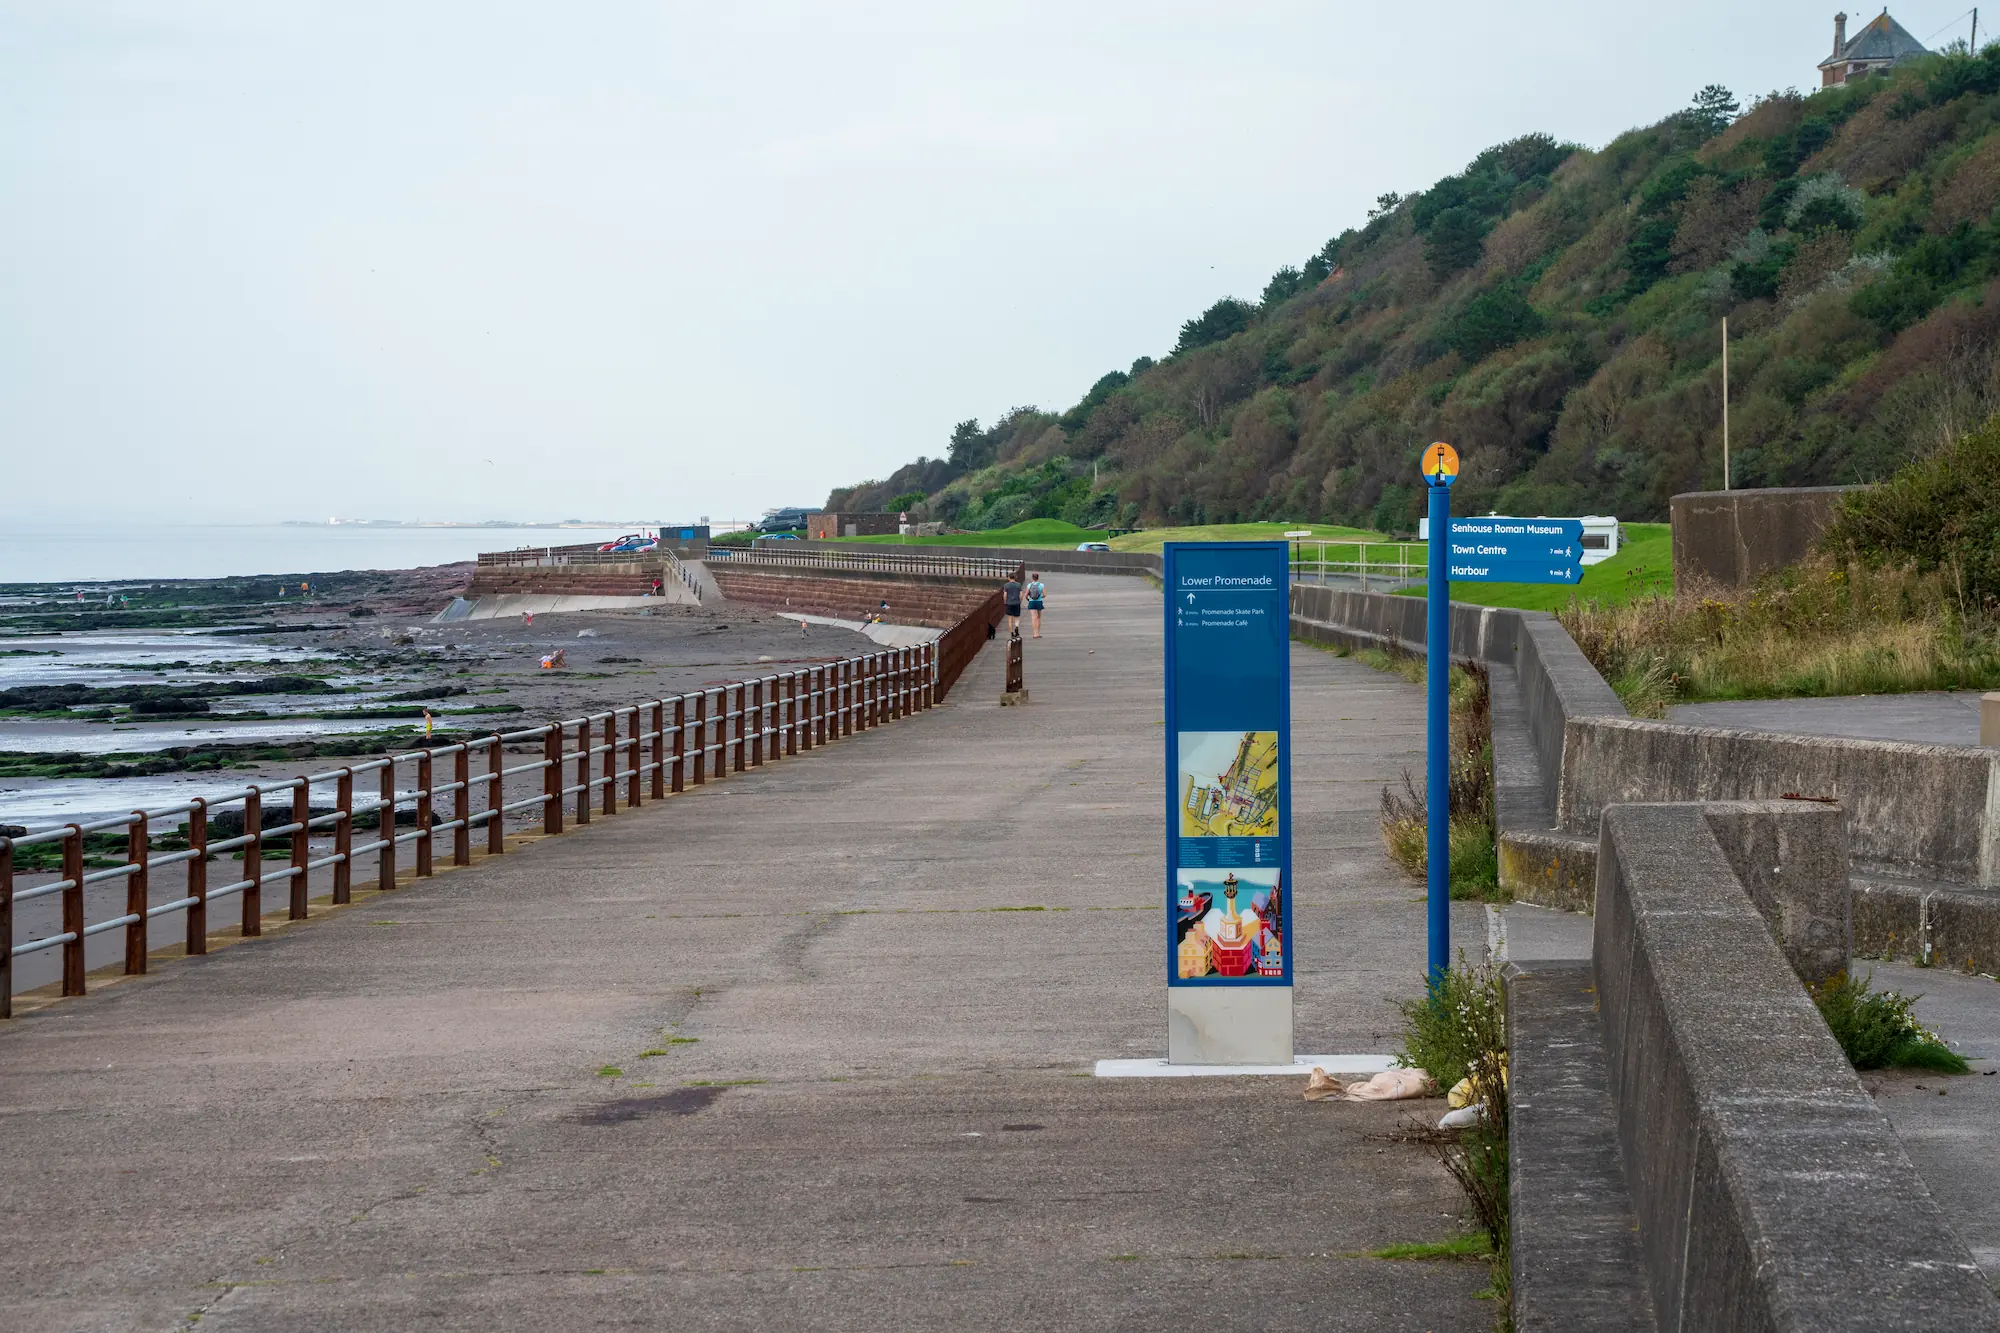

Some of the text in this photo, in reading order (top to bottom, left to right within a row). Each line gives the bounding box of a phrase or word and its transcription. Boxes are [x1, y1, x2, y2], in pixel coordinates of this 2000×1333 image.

[1452, 523, 1563, 534] Senhouse Roman Museum
[1452, 545, 1475, 555] Town
[1477, 545, 1507, 555] Centre
[1452, 566, 1489, 576] Harbour
[1182, 576, 1272, 586] Lower Promenade
